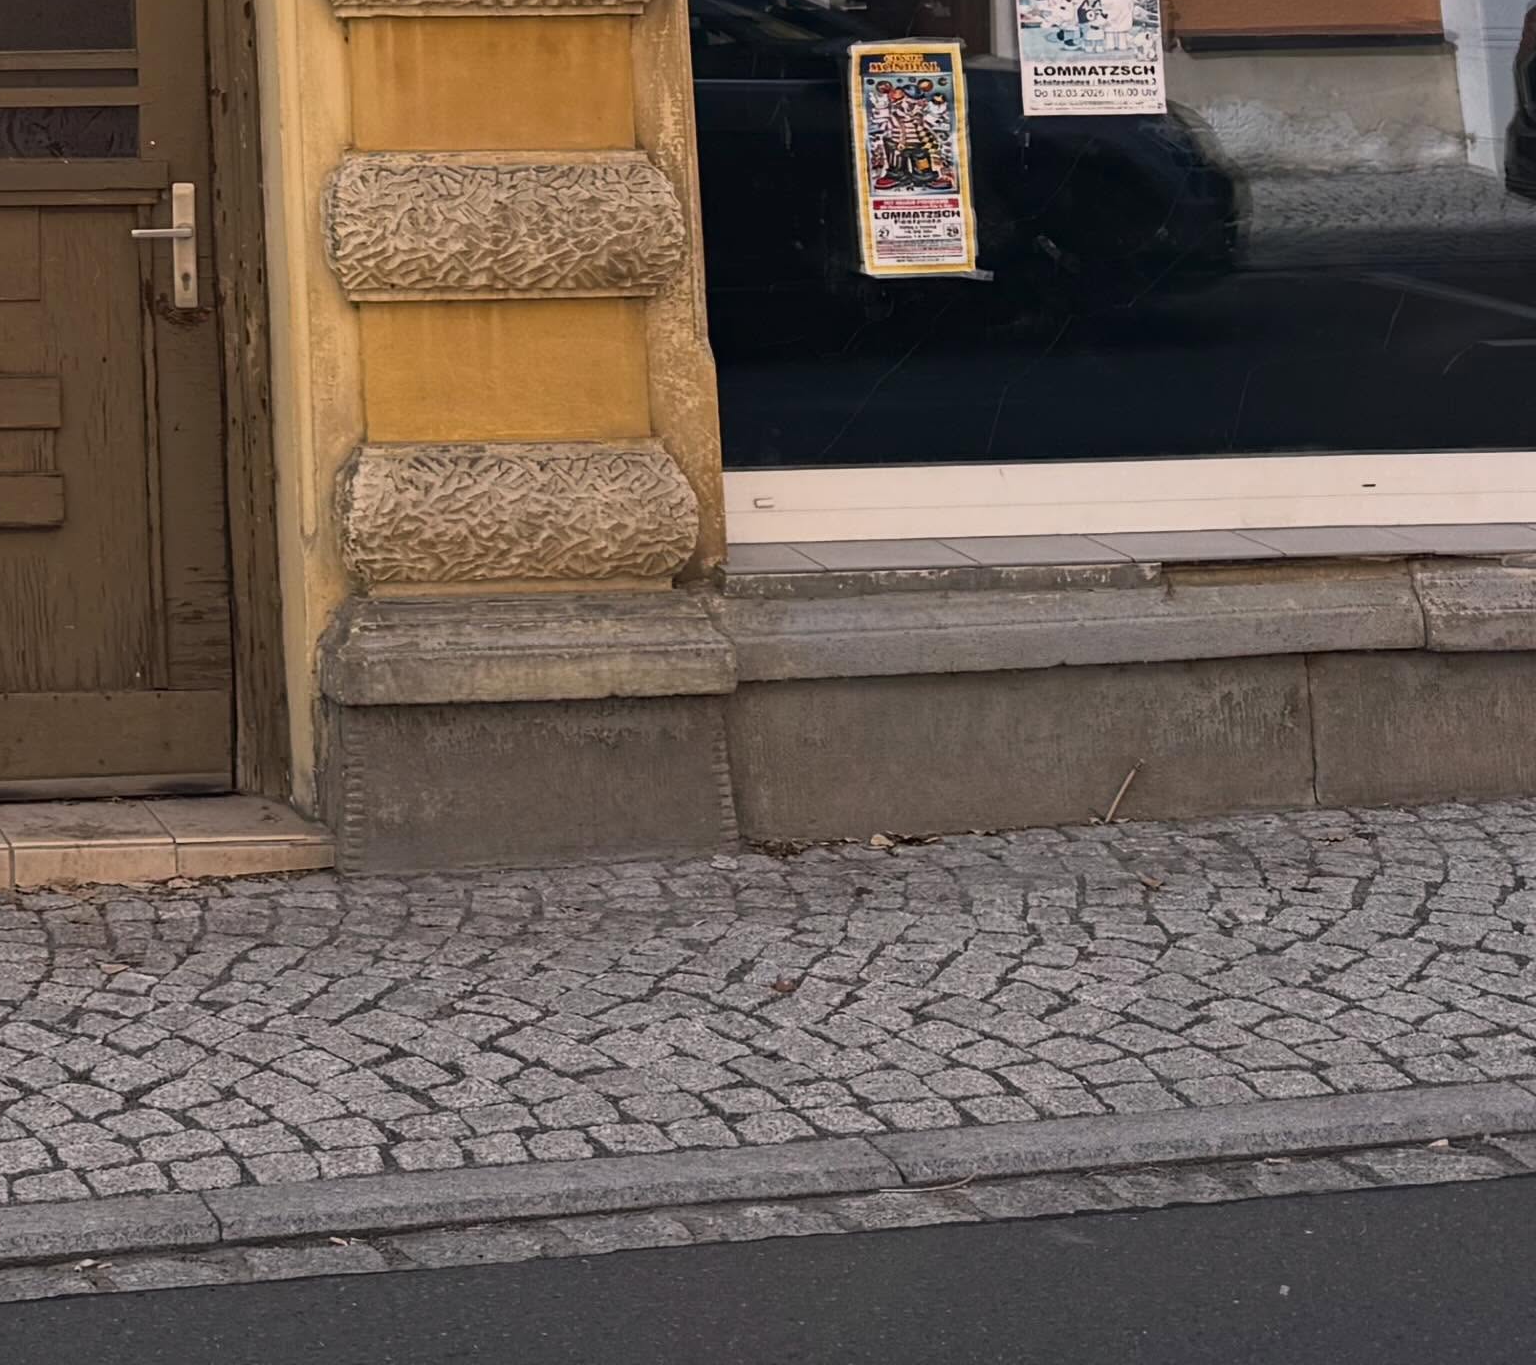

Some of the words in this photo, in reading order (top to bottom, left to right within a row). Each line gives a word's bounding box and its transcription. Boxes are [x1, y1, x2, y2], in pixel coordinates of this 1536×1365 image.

[1033, 65, 1156, 76] LOMMATZSCH
[1034, 89, 1048, 98] Do
[874, 210, 961, 220] LOMMATZSCH
